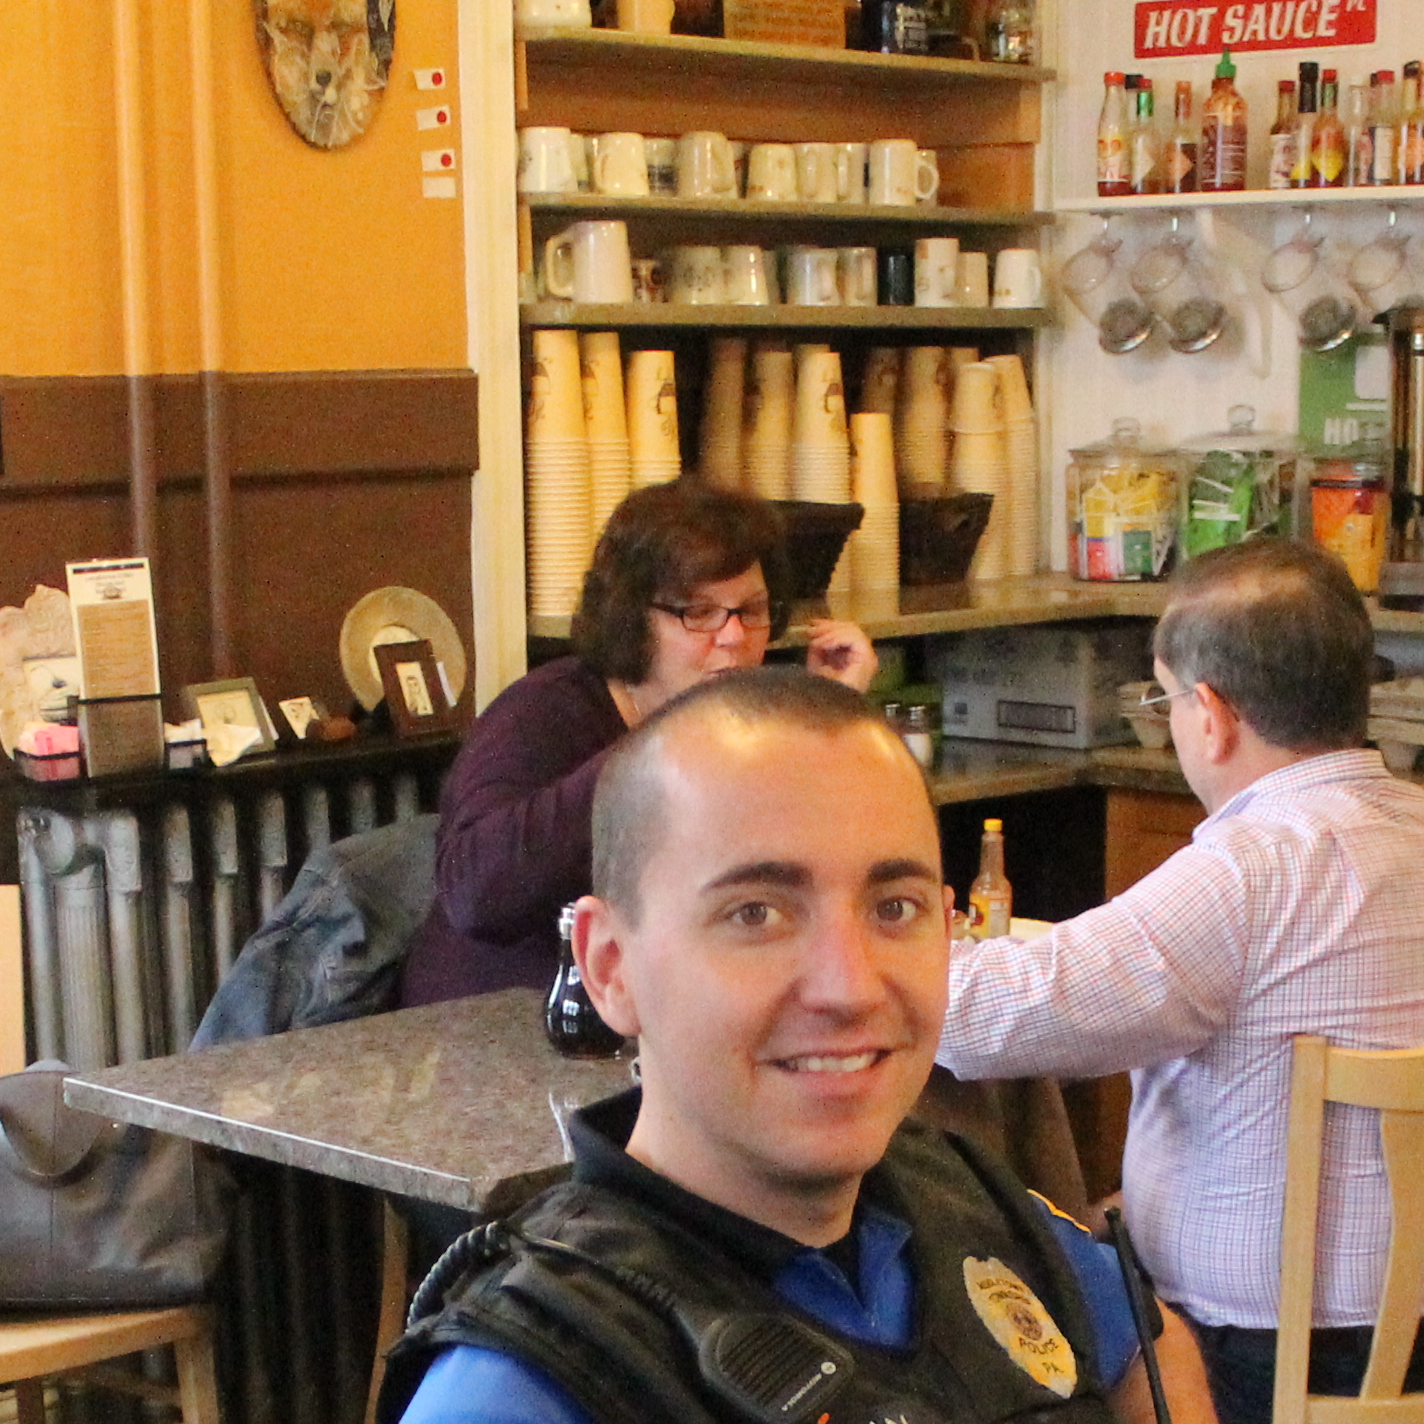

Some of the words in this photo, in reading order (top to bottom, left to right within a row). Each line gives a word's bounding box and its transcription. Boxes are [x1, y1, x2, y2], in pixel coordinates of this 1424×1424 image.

[1144, 7, 1219, 49] HOT
[1222, 0, 1341, 44] SAUCE
[1018, 1337, 1060, 1355] POLICE
